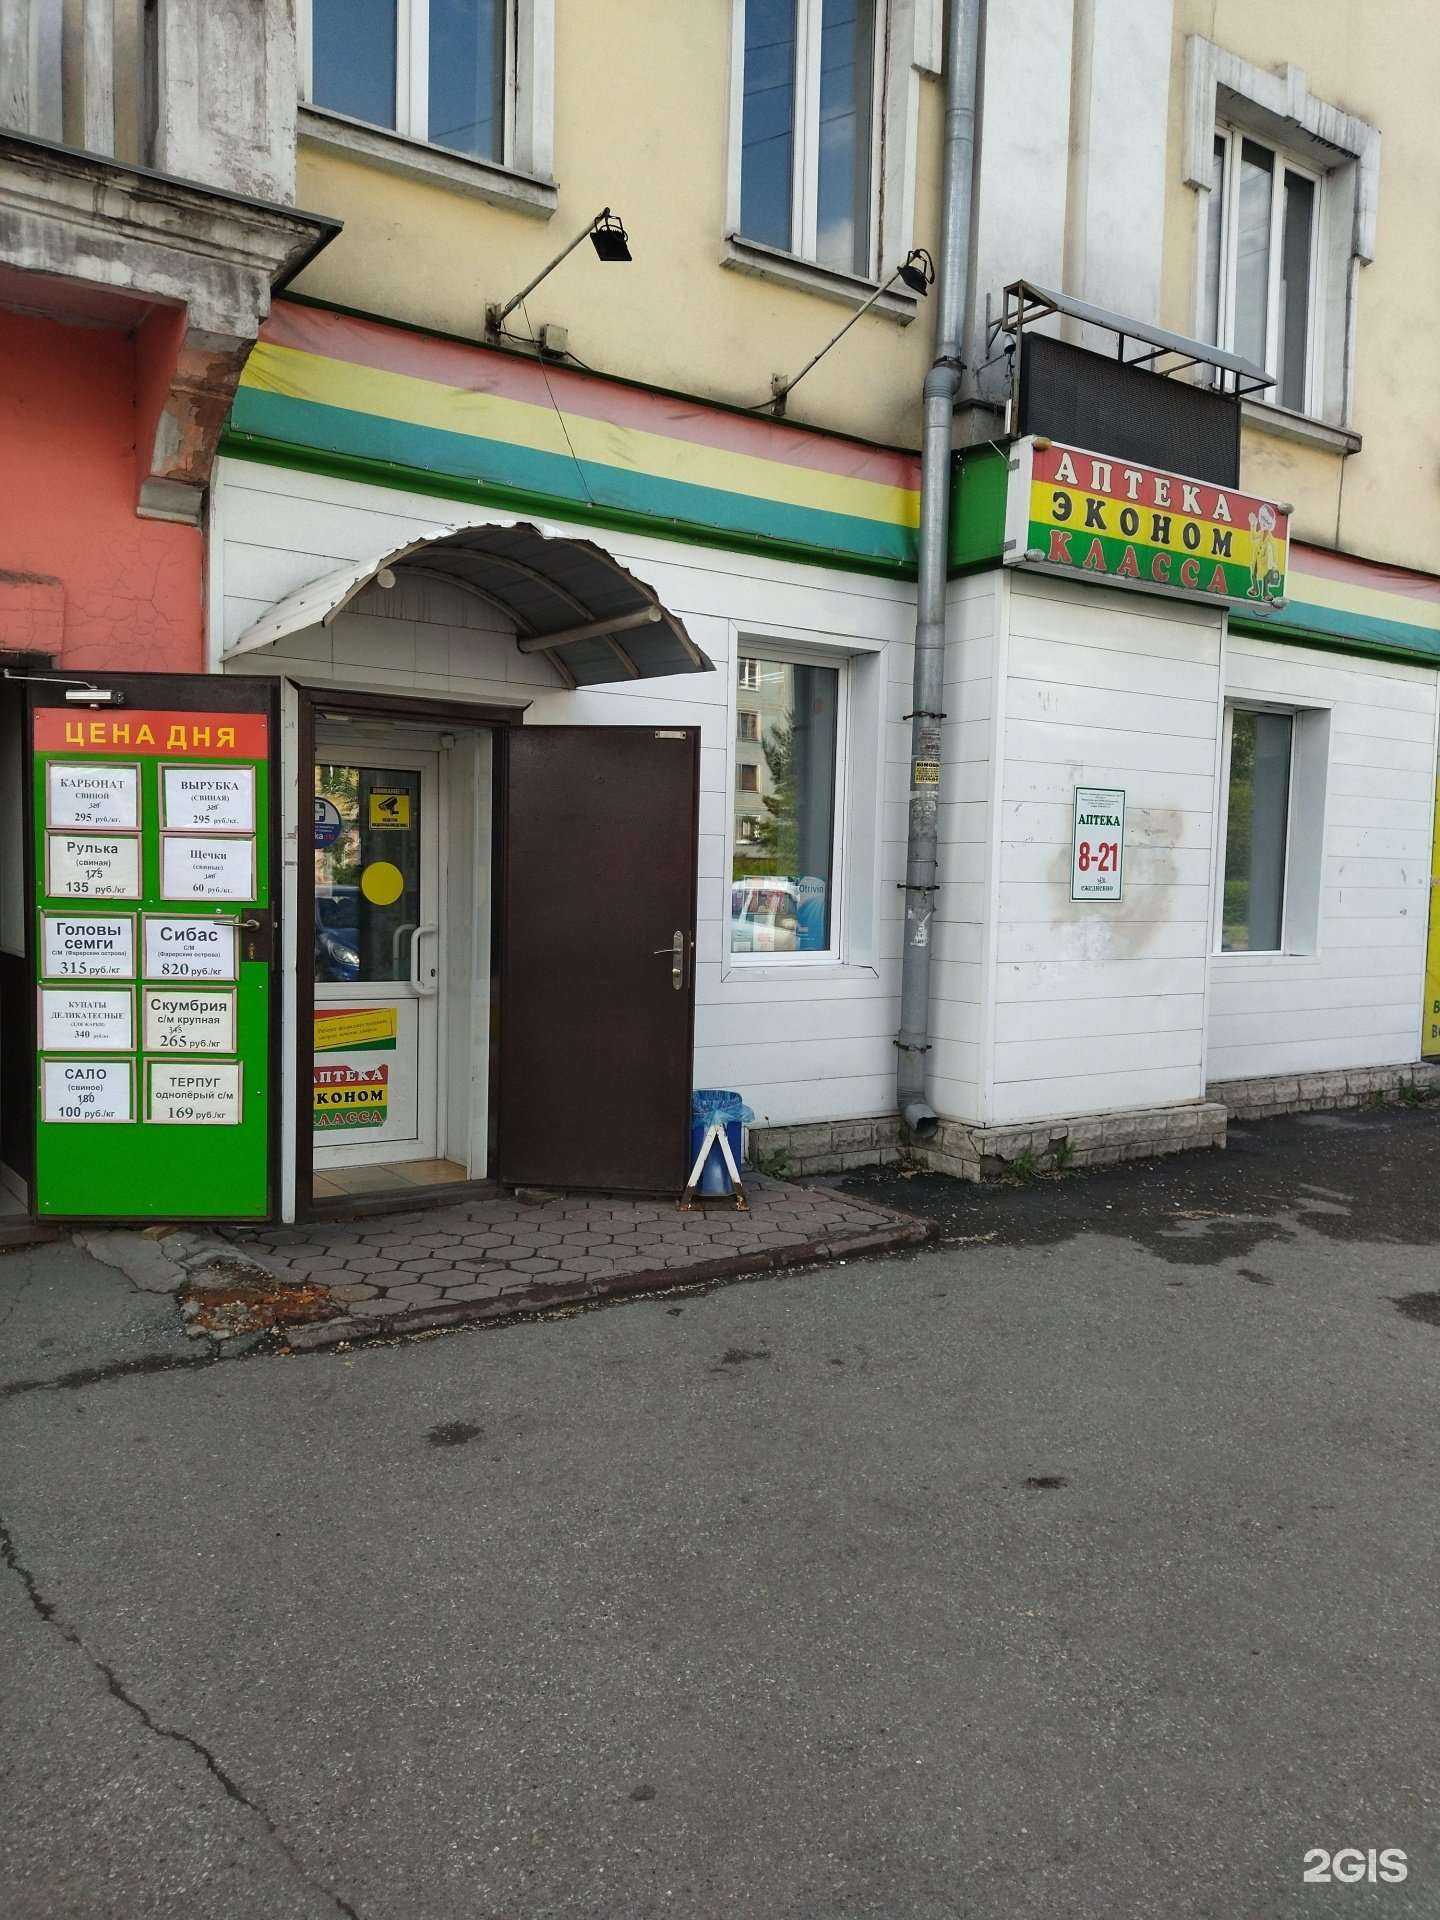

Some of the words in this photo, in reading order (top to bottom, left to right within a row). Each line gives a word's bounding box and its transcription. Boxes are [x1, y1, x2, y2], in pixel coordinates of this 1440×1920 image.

[1054, 452, 1232, 522] АПТЕКА
[1051, 491, 1232, 558] ЭКОНОМ
[1047, 529, 1228, 594] КЛАССА
[65, 721, 156, 747] ЦЕНА
[167, 725, 236, 750] ДНЯ
[60, 778, 126, 789] КАРБОНАТ
[181, 781, 239, 791] ВЫРУБКА
[75, 812, 92, 822] 295
[193, 815, 210, 824] 295
[1078, 814, 1121, 827] АПТЕКА
[67, 841, 118, 855] Рулька
[190, 850, 227, 860] Щечки
[1078, 841, 1118, 872] 8-21
[75, 859, 111, 868] (свиная)
[85, 869, 103, 880] 175
[66, 881, 89, 893] 135
[95, 885, 126, 894] руб./кг
[193, 884, 204, 892] 60
[57, 922, 121, 936] Головы
[160, 926, 218, 942] Сибас
[64, 939, 113, 949] семги
[60, 961, 87, 975] 315
[89, 966, 120, 976] руб./кг
[161, 963, 189, 975] 820
[191, 967, 222, 977] руб./кг
[151, 998, 227, 1014] Скумбрия
[157, 1015, 174, 1024] с/м
[177, 1016, 220, 1026] крупная
[74, 1030, 90, 1039] 340
[160, 1035, 187, 1048] 265
[189, 1039, 221, 1049] руб./кг
[64, 1068, 107, 1080] САЛО
[68, 1084, 103, 1092] (свиное)
[169, 1077, 221, 1088] ТЕРПУГ
[217, 1091, 234, 1100] с/м
[314, 1090, 384, 1104] КОНОМ
[58, 1106, 81, 1118] 100
[84, 1109, 115, 1119] руб./кг
[168, 1106, 194, 1119] 169
